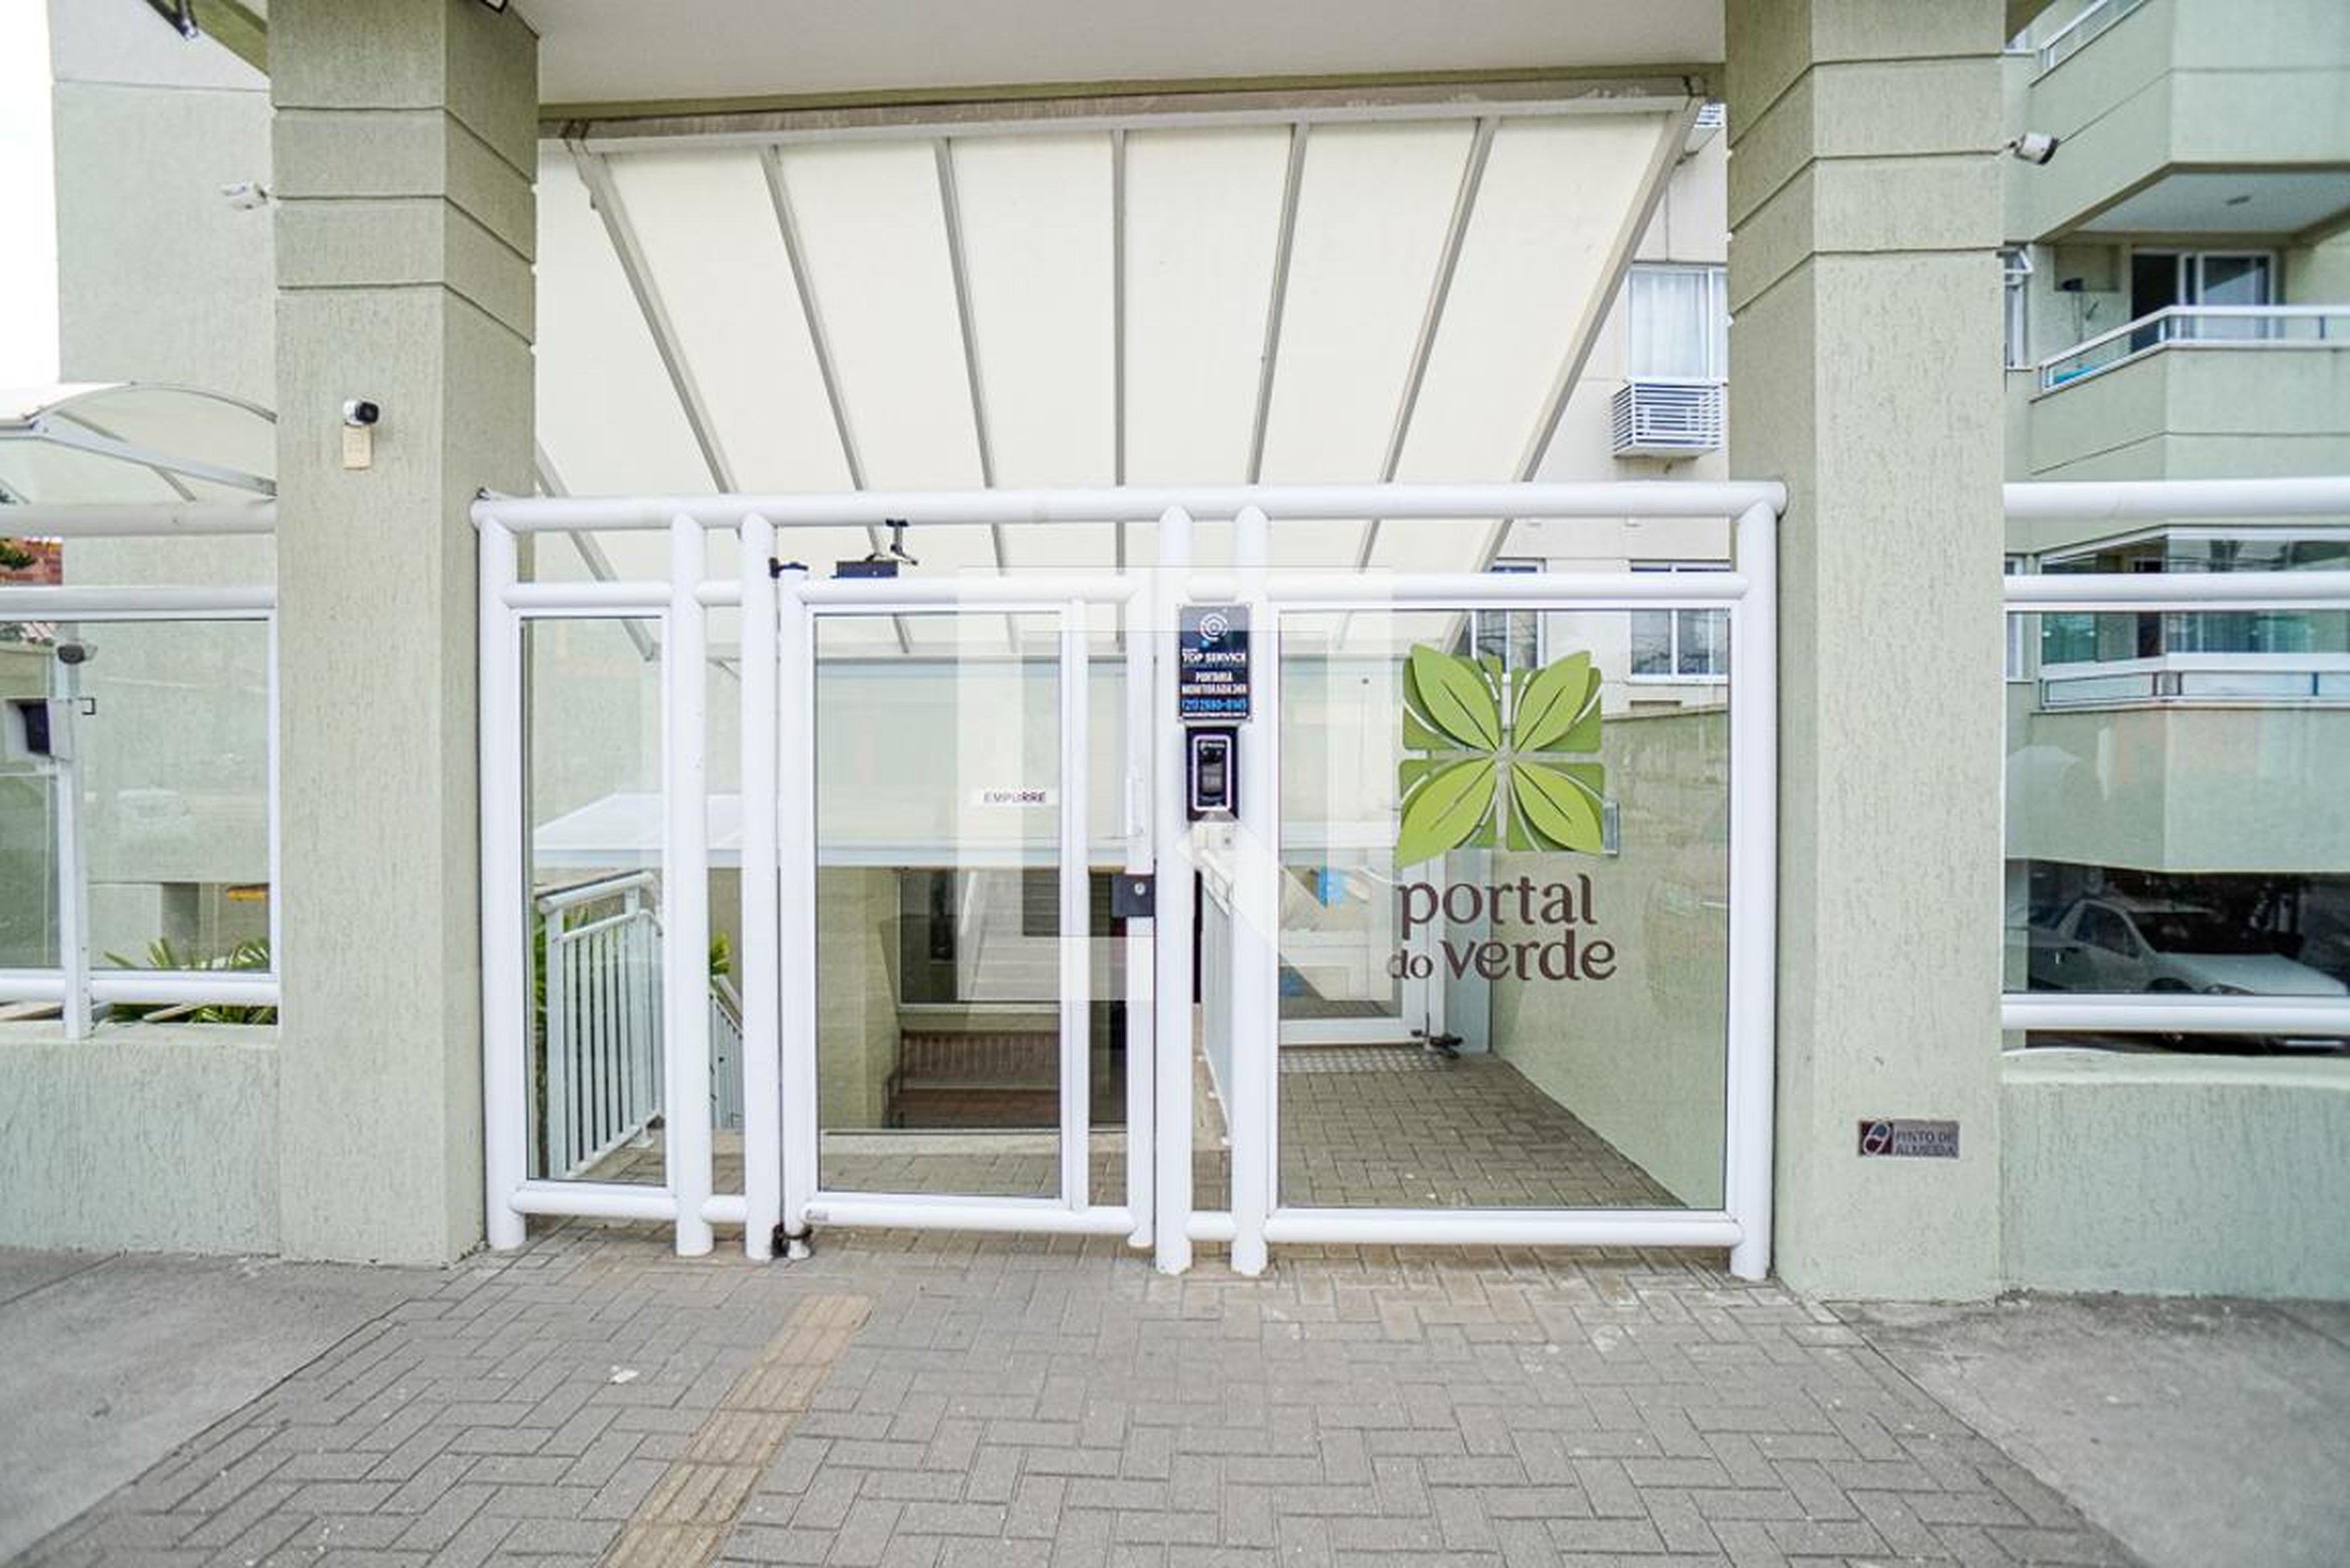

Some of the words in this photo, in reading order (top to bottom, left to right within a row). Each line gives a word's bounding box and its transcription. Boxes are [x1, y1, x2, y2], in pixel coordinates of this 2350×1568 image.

[1182, 652, 1204, 663] TOP
[1206, 652, 1247, 663] SERVICE
[1195, 671, 1234, 682] PORTARIA
[983, 791, 1046, 803] EMPURRE
[1397, 873, 1598, 941] portal
[1387, 948, 1433, 979] do
[1439, 928, 1617, 981] verde
[1895, 1130, 1934, 1143] PINTO
